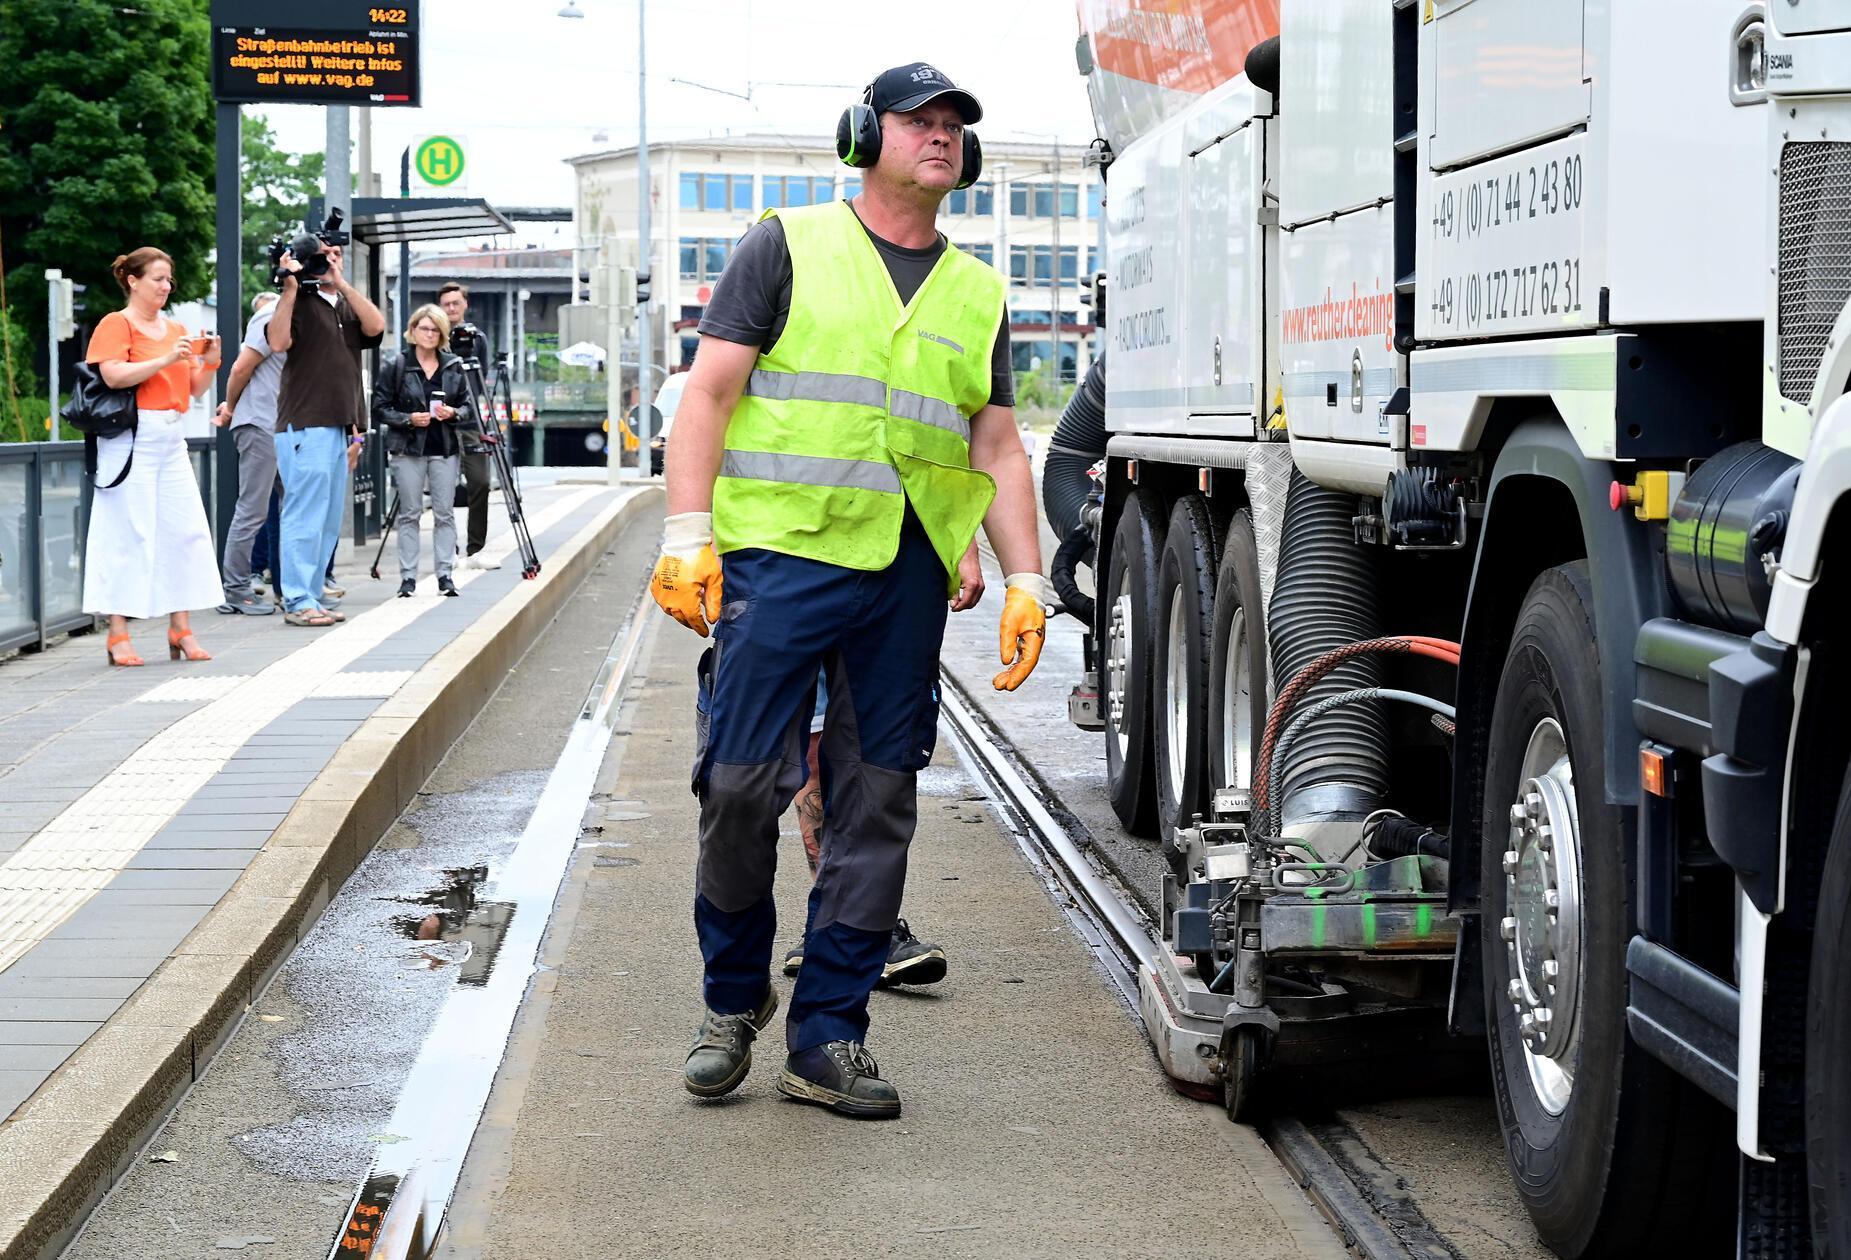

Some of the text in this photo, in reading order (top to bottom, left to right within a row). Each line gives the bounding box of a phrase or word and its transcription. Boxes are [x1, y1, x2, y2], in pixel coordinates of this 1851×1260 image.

[369, 8, 407, 23] 14:22
[236, 37, 396, 55] Straßenbahnbetrieb ist
[310, 55, 366, 71] Weitere
[367, 57, 403, 71] Infos
[1770, 54, 1793, 69] SCANIA
[256, 71, 375, 88] auf www.vag.de
[429, 147, 451, 175] H
[1433, 190, 1454, 240] +49
[1457, 187, 1462, 243] /
[1466, 181, 1482, 239] (0)
[1432, 258, 1582, 331] +49 / (0) 172 717 62 31
[1282, 276, 1393, 352] www.reuther.cleaning
[917, 328, 936, 342] VAG
